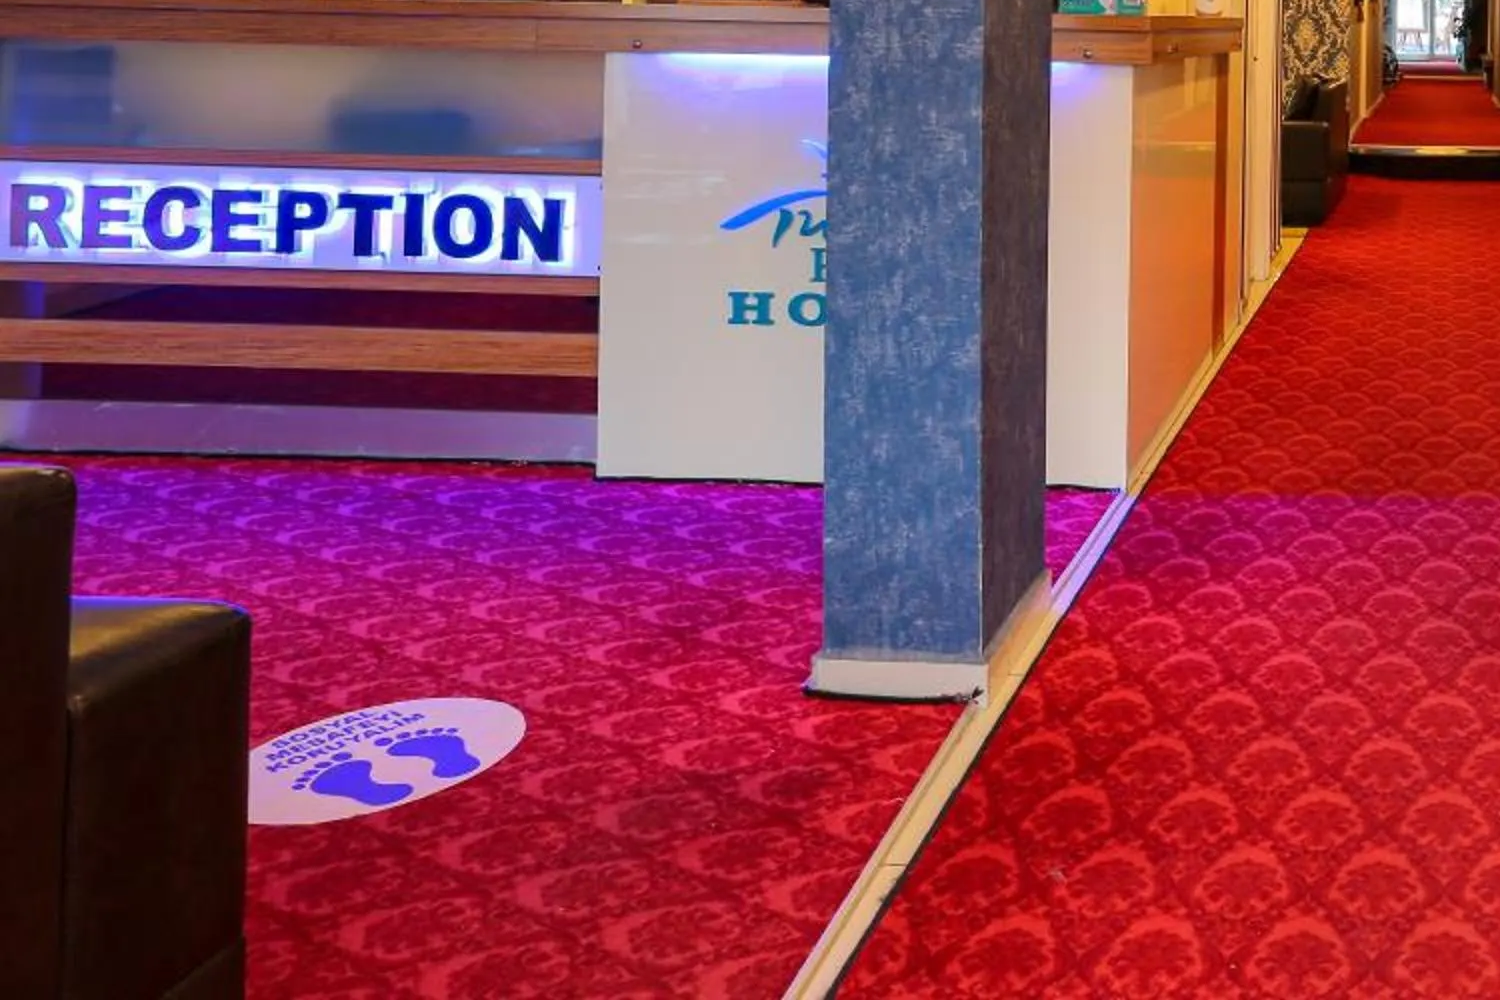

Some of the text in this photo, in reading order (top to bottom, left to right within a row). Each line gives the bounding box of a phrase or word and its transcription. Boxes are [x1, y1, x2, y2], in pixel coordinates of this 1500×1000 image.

[9, 182, 563, 263] RECEPTION
[265, 712, 425, 773] KORUYALIM
[271, 711, 375, 749] SOSYAL
